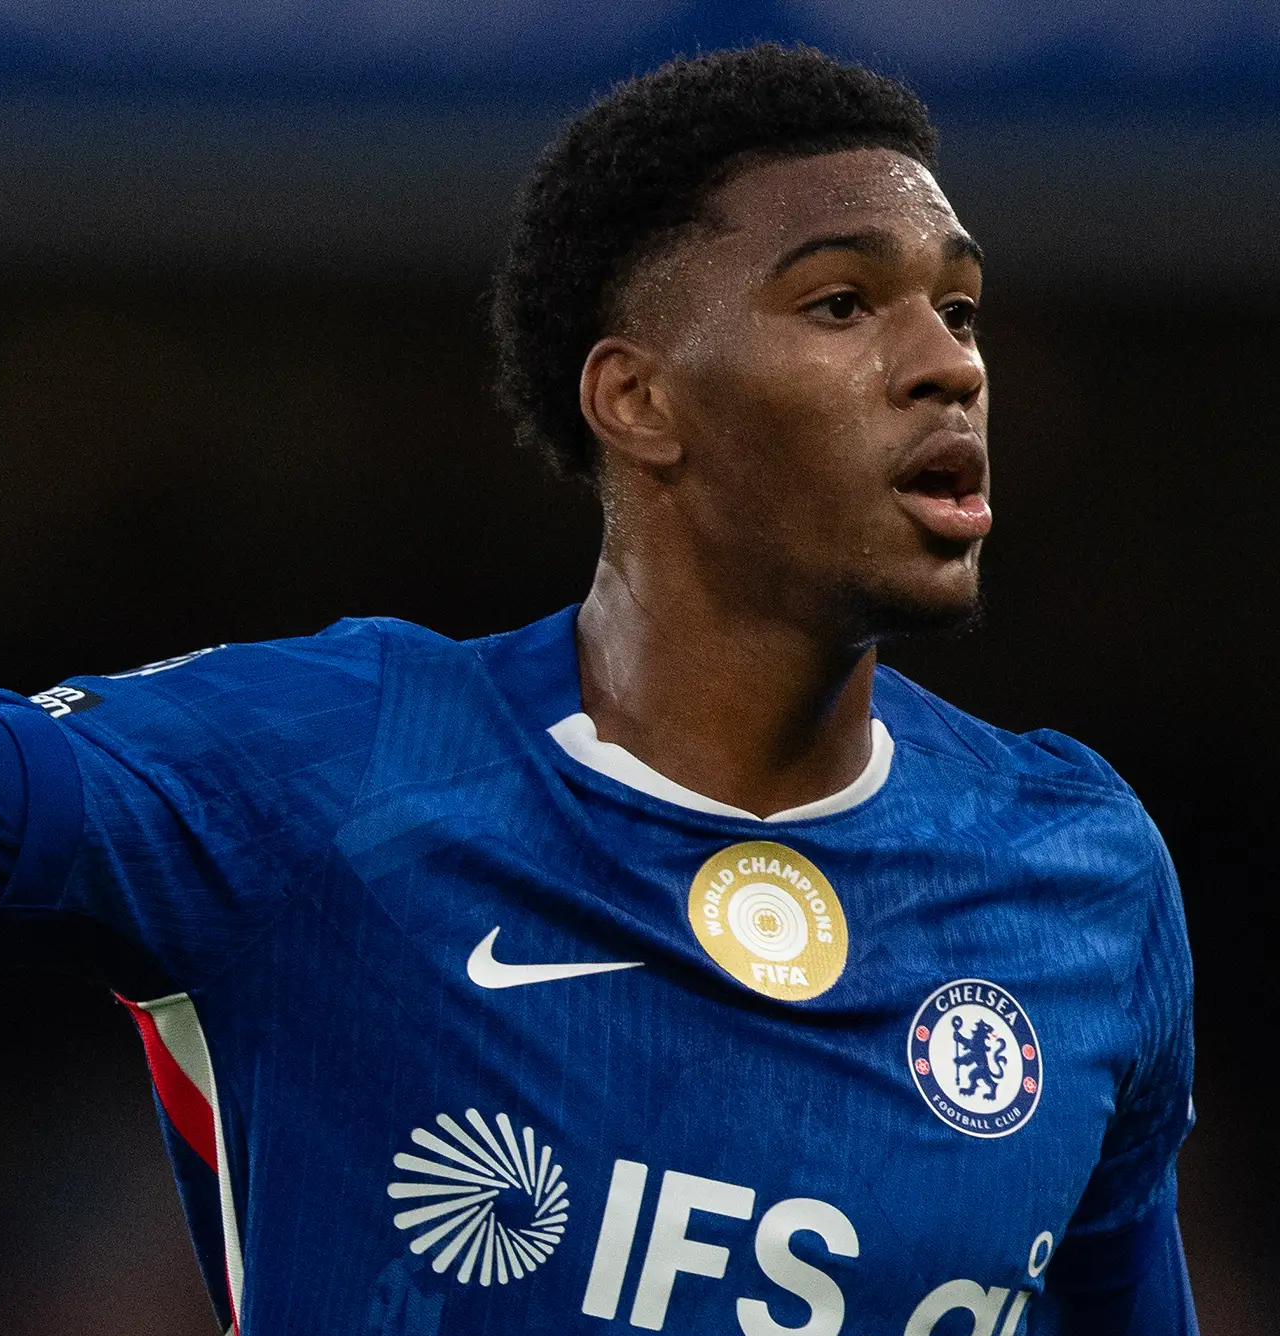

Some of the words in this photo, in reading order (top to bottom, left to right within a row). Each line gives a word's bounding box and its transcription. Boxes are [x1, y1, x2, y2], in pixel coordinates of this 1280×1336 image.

[703, 868, 735, 937] WORLD
[737, 856, 833, 944] CHAMPIONS
[751, 963, 810, 986] FIFA
[935, 985, 1019, 1026] CHELSEA
[932, 1094, 991, 1130] FOOTBALL
[995, 1106, 1022, 1128] CLUB
